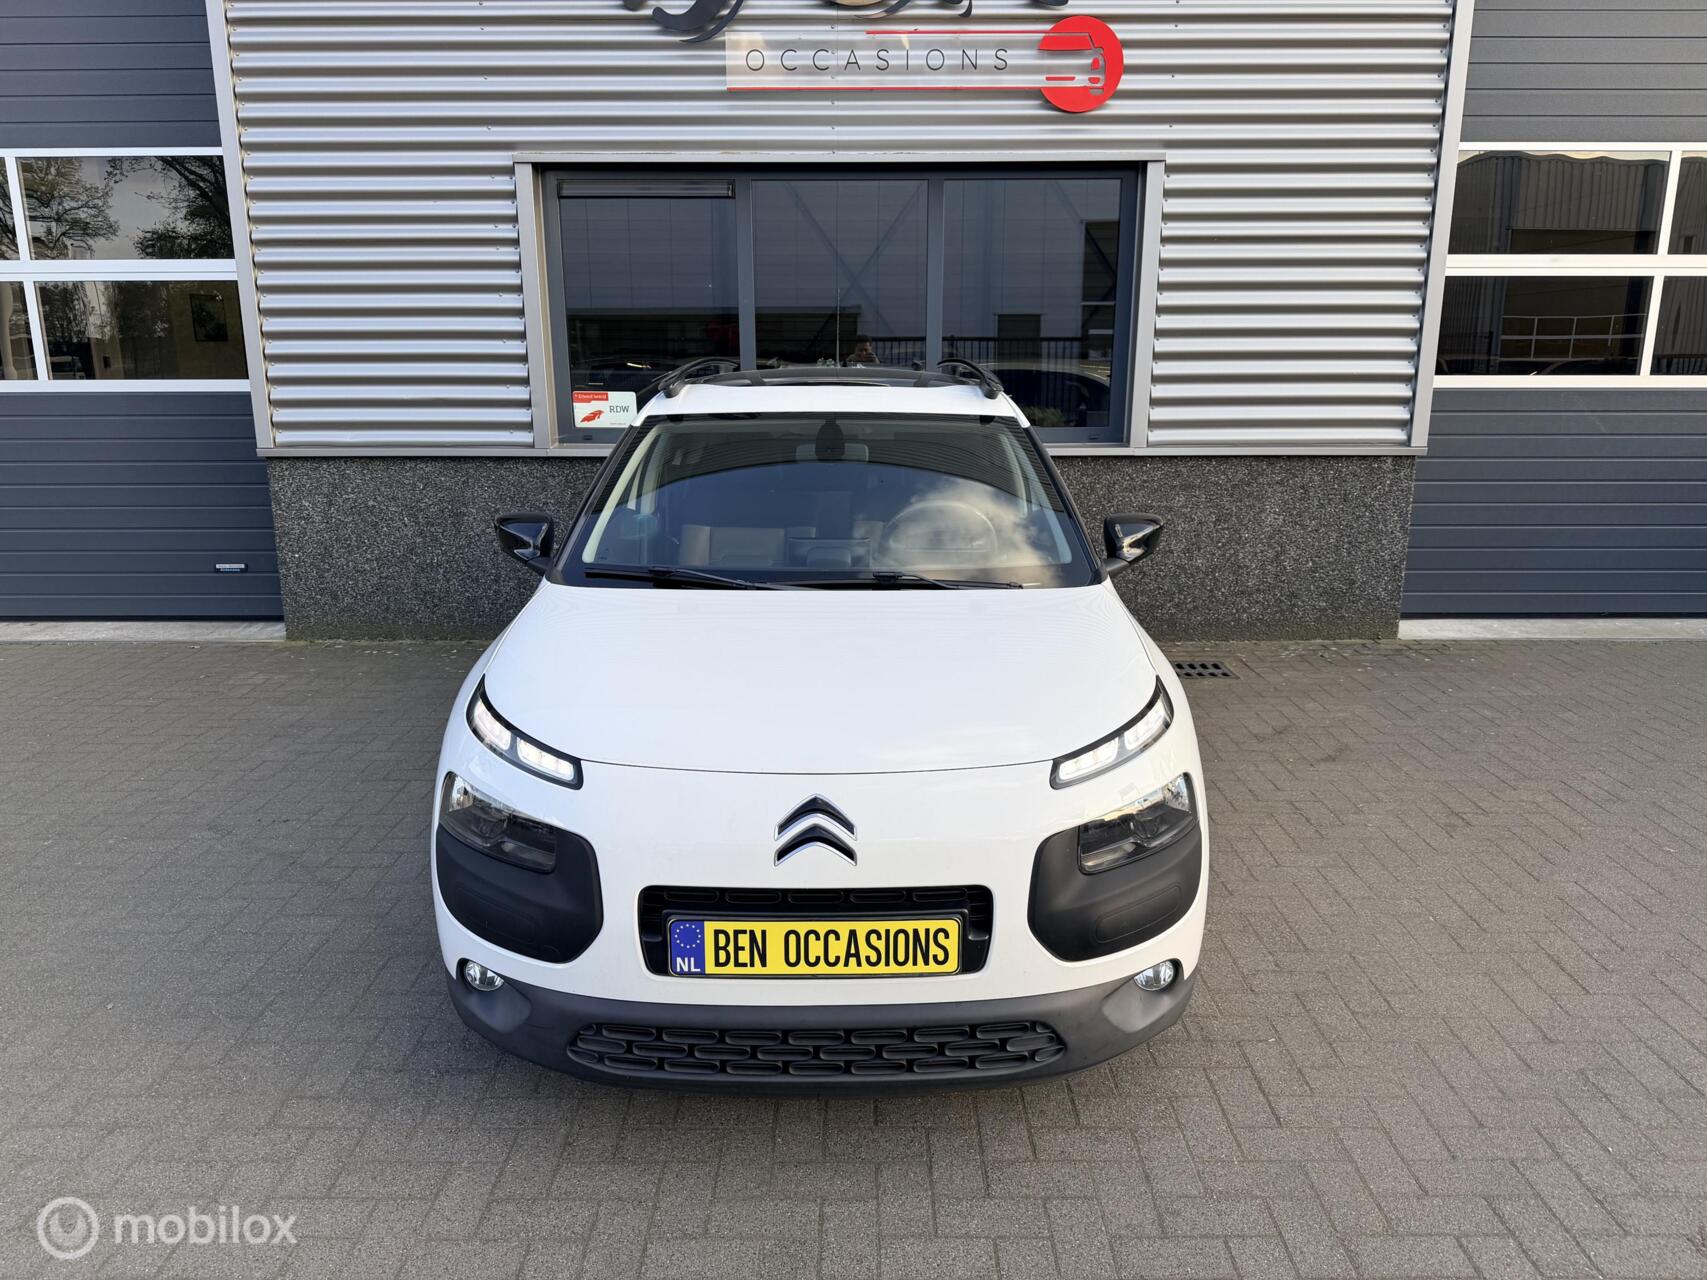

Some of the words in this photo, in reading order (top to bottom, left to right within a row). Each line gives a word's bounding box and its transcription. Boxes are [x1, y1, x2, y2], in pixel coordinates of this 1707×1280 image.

[745, 48, 1010, 72] OCCASIONS
[609, 405, 630, 414] RDW
[713, 929, 767, 968] BEN
[784, 927, 950, 968] OCCASIONS
[676, 957, 701, 972] NL
